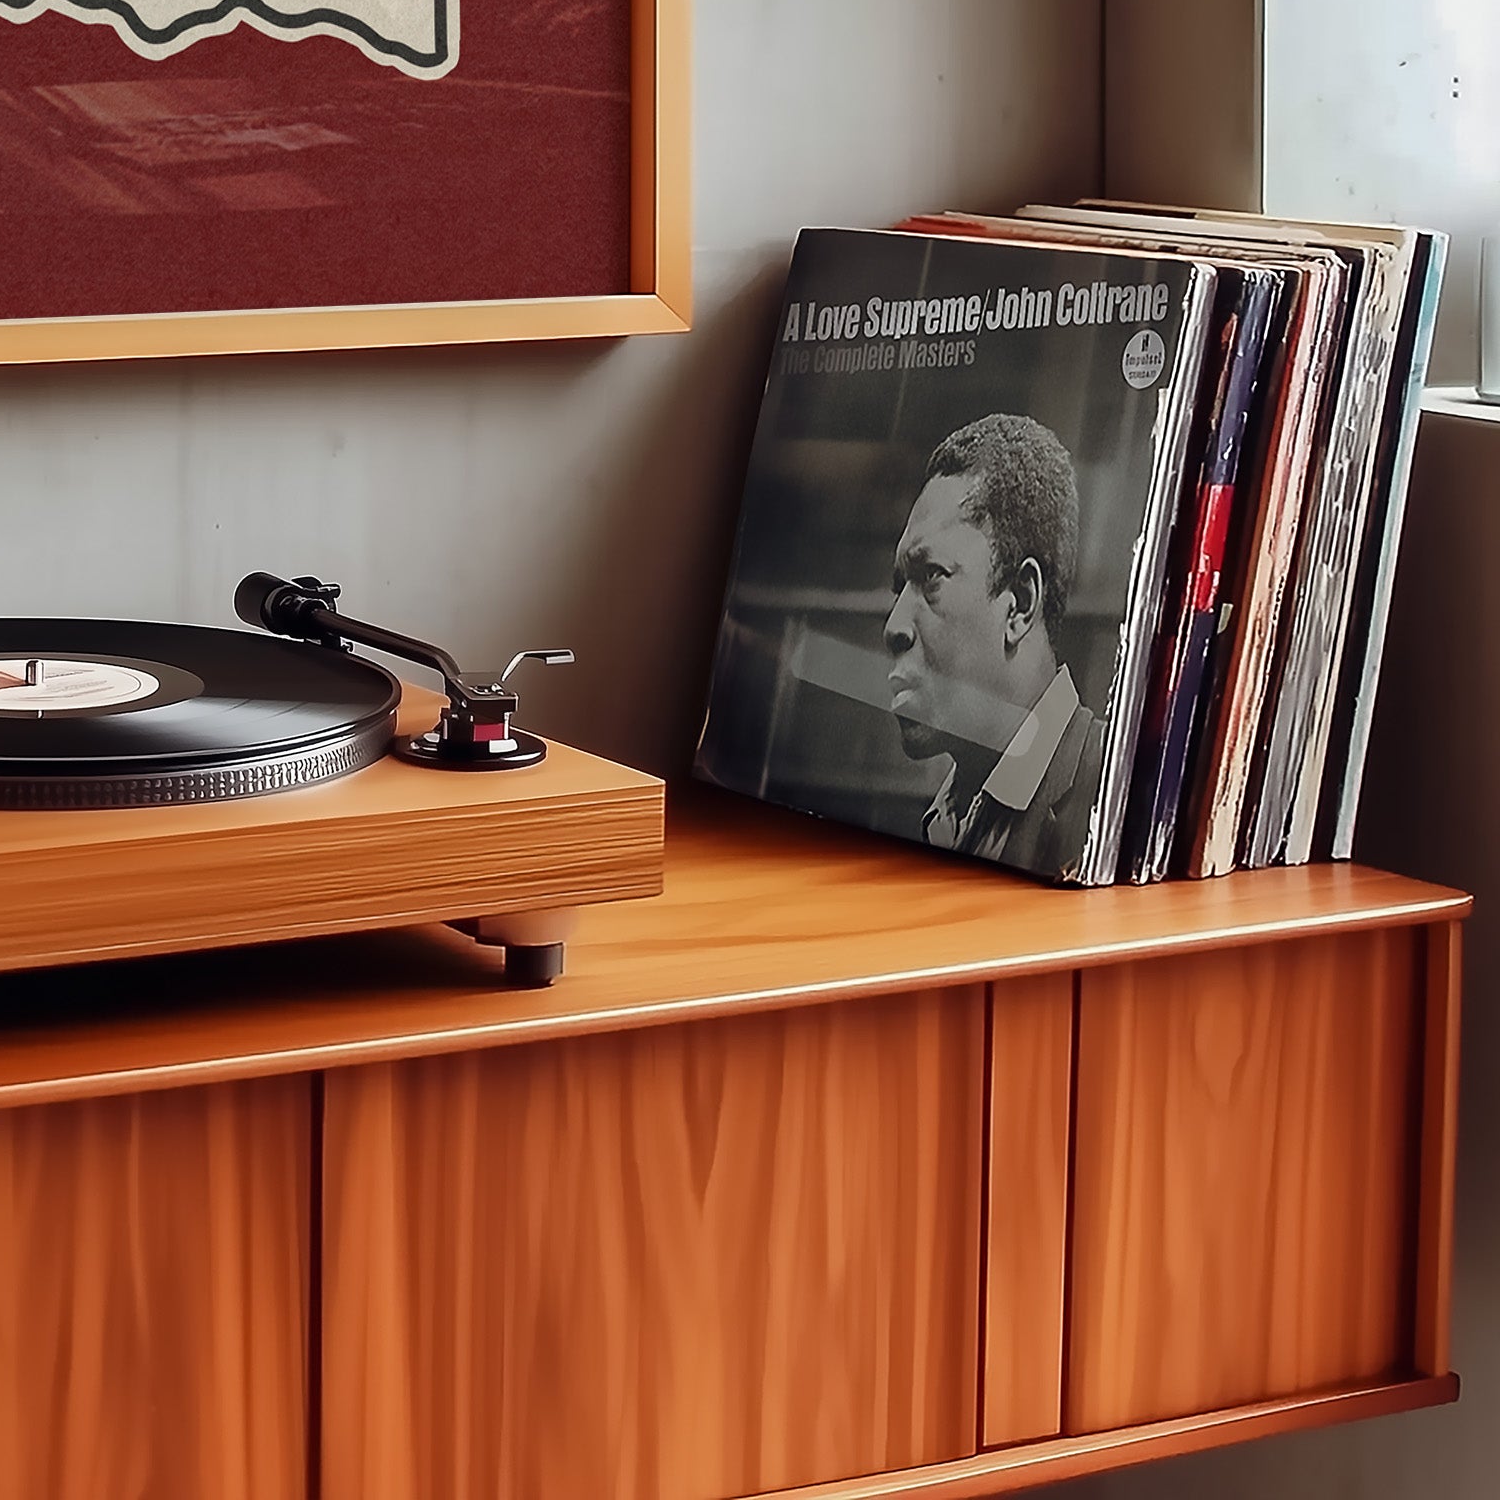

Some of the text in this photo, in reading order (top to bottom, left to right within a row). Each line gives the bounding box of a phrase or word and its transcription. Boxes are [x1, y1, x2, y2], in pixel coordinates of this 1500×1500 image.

[782, 302, 800, 342] A
[804, 301, 861, 341] Love
[1056, 281, 1169, 326] Coltrane
[780, 338, 977, 376] The Complete Masters
